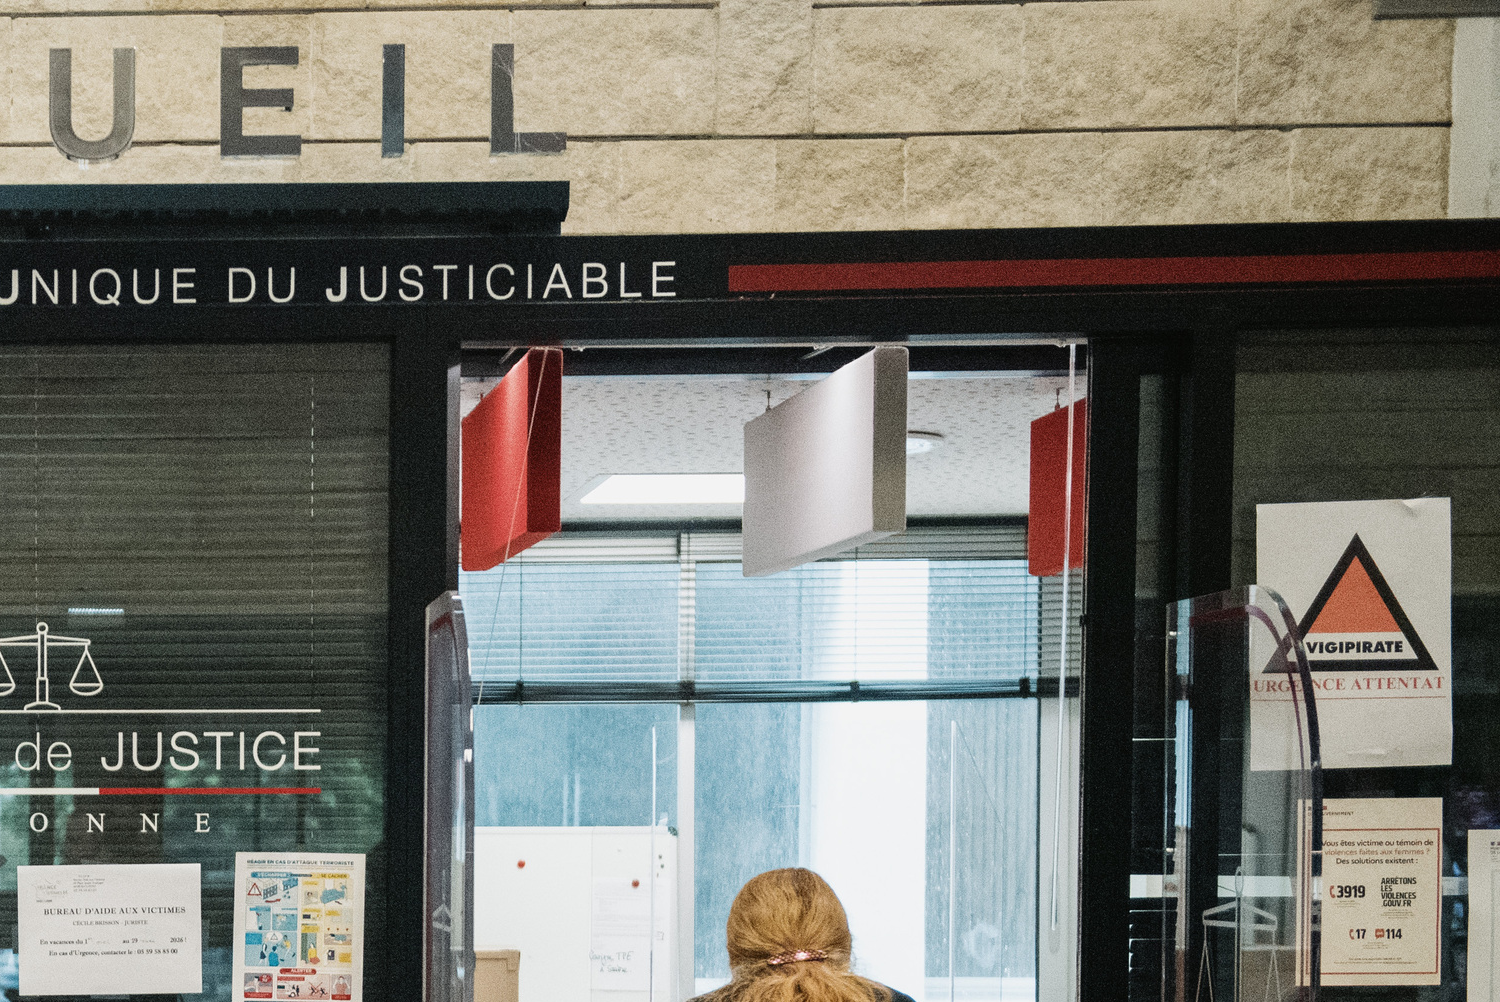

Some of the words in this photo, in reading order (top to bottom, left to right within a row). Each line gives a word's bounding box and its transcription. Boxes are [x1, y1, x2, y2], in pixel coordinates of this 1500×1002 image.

[228, 267, 296, 304] DU
[325, 261, 676, 302] JUSTICIABLE
[1305, 640, 1404, 654] VIGIPIRATE
[1350, 676, 1445, 691] ATTENTAT
[14, 731, 73, 772] de
[101, 731, 322, 772] JUSTICE
[1340, 839, 1356, 847] êtes
[1356, 839, 1384, 847] victime
[1396, 839, 1423, 847] témoin
[1423, 838, 1434, 847] de
[1335, 857, 1350, 865] Des
[1351, 857, 1384, 865] solutions
[1385, 857, 1415, 865] existent
[1380, 876, 1417, 885] ARRÊTONS
[1336, 885, 1366, 898] 3919
[1380, 892, 1417, 900] VIOLENCES
[84, 907, 117, 915] D'AIDE
[141, 906, 186, 914] VICTIMES
[1355, 928, 1367, 939] 17
[1385, 928, 1403, 939] 114
